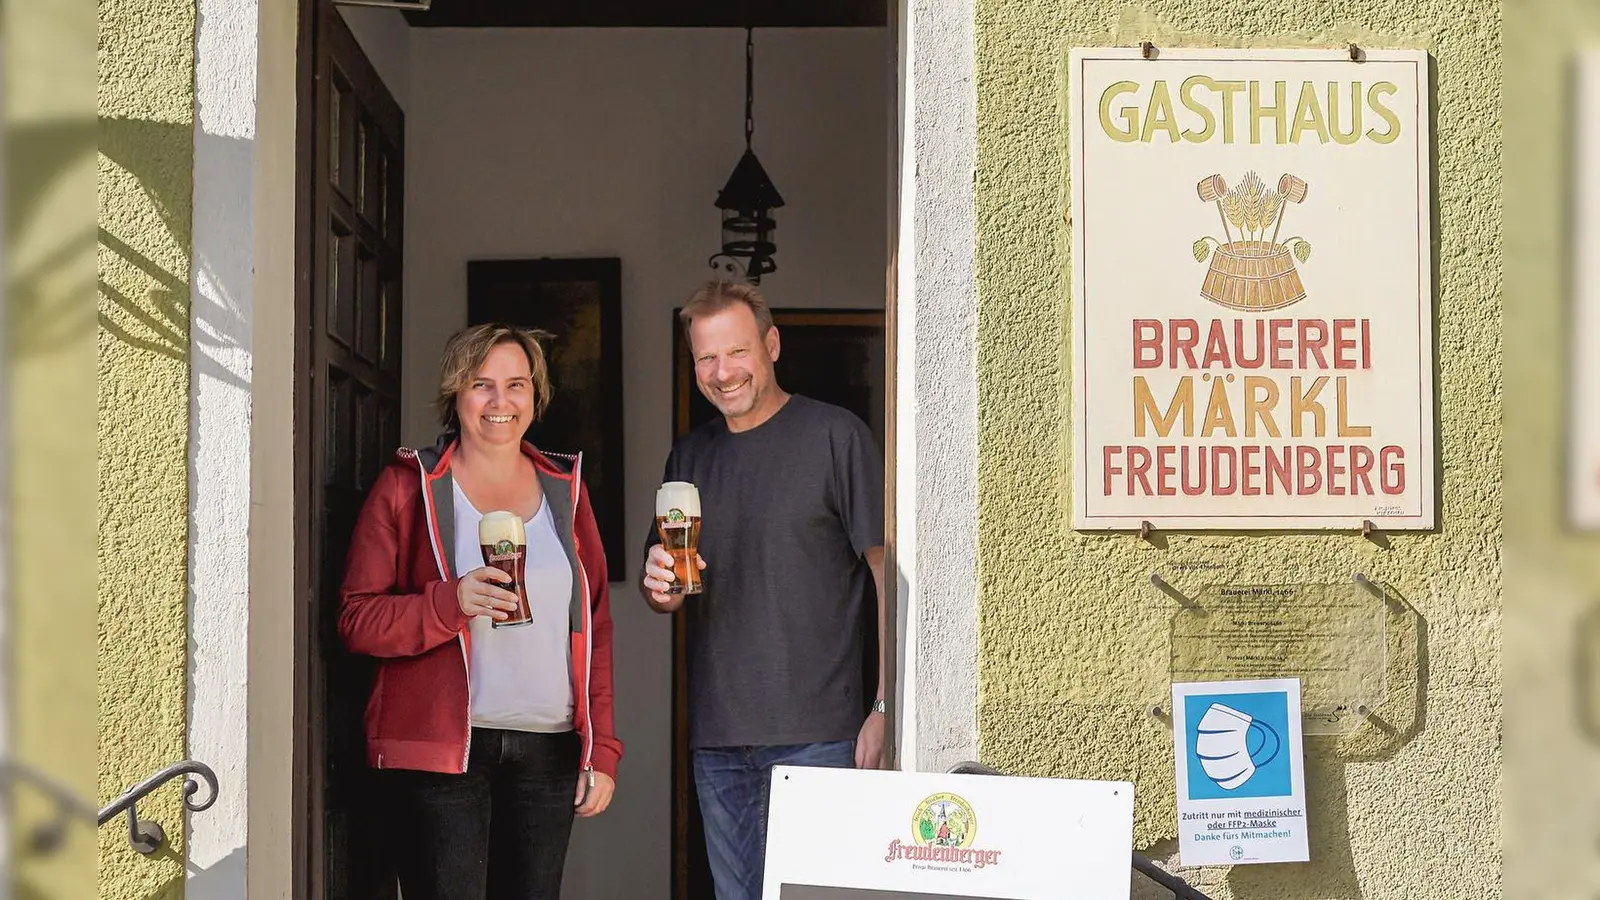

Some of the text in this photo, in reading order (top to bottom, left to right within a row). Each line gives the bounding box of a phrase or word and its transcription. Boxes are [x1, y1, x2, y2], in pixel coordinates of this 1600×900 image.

[1099, 75, 1401, 145] GASTHAUS
[1133, 319, 1371, 370] BRAUEREI
[1133, 373, 1372, 438] MÄRKL
[1103, 445, 1405, 496] FREUDENBERG
[1182, 811, 1209, 820] Zutritt
[1227, 809, 1242, 819] mit
[1244, 808, 1302, 818] medizinischer
[1207, 819, 1277, 830] oder FFP2-Maske
[885, 838, 1001, 869] Freudenberger
[1194, 829, 1292, 842] Danke fürs Mitmachen!
